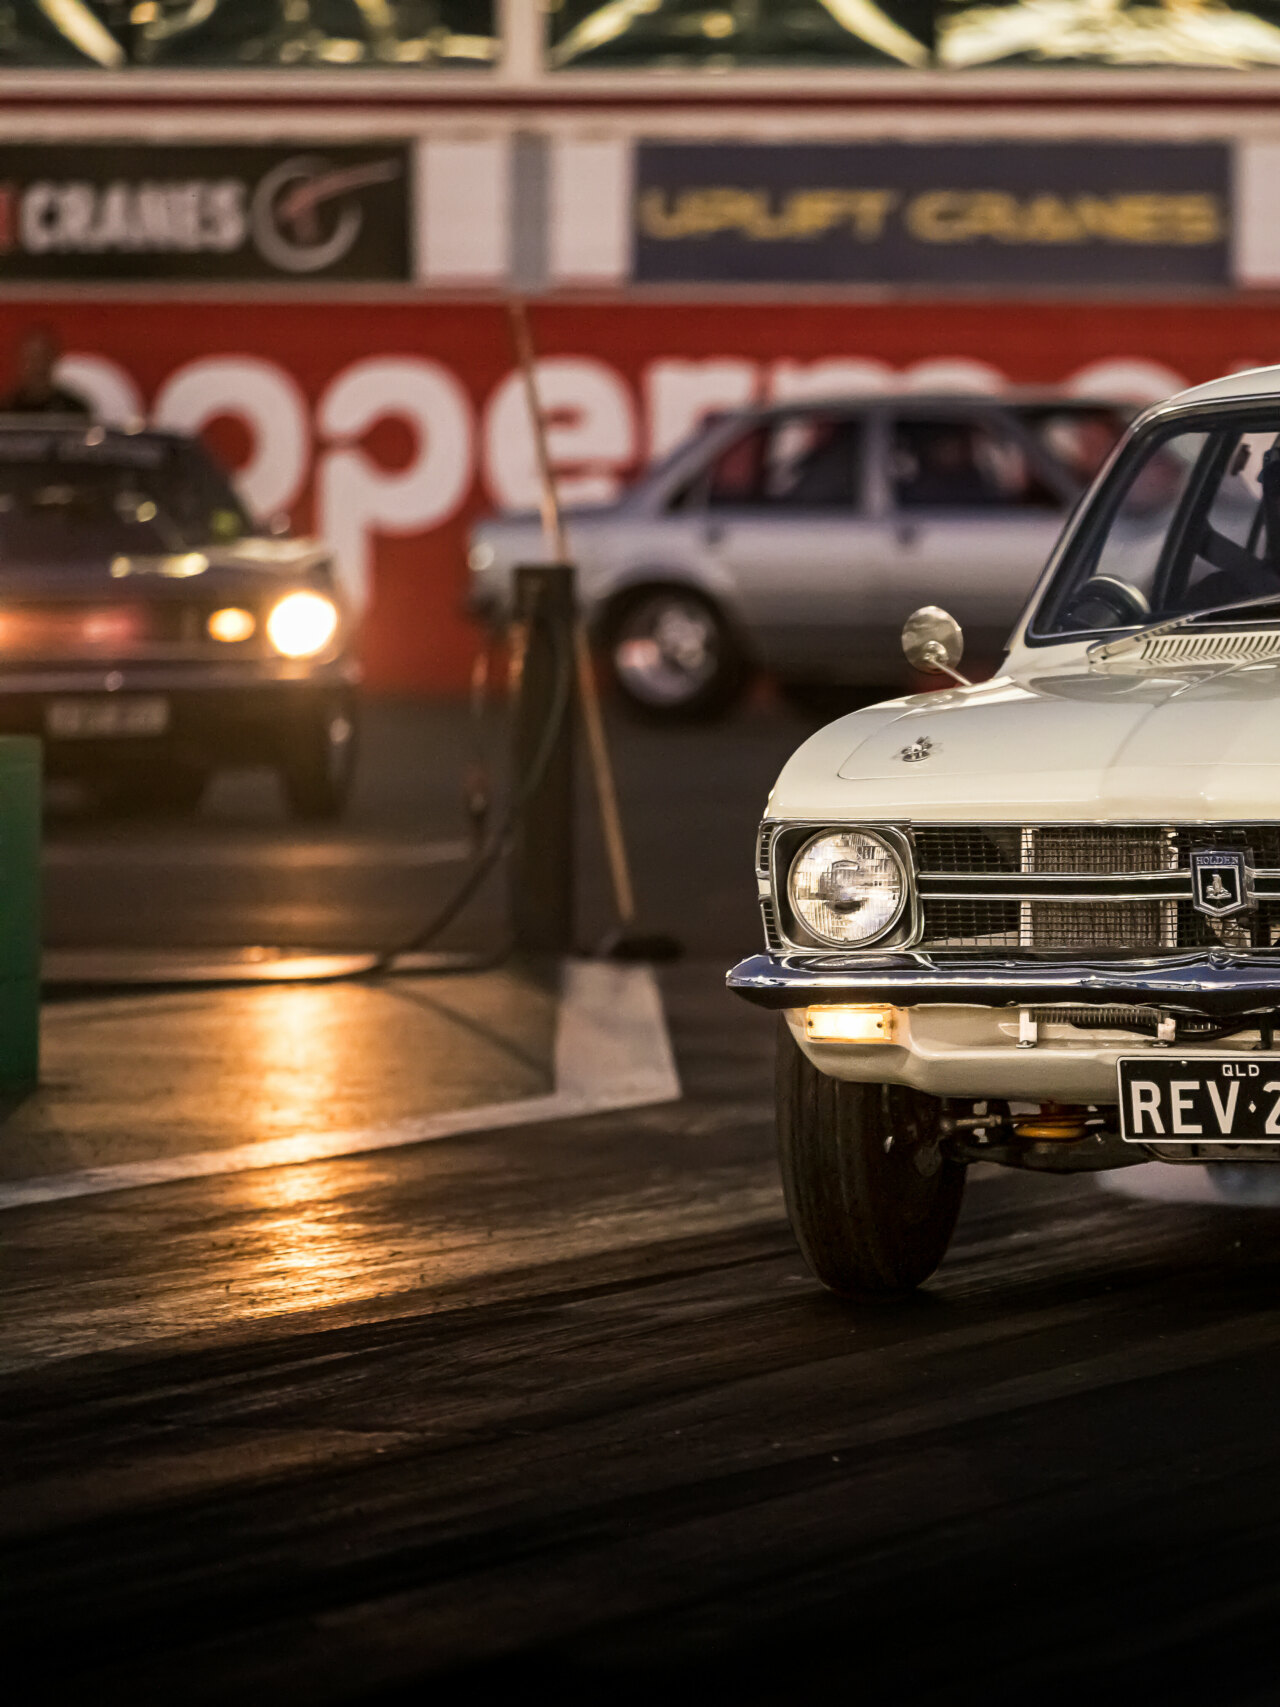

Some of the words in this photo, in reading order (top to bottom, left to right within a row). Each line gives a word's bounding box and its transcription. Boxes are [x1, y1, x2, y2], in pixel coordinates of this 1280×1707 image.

[25, 180, 244, 251] CRANES
[638, 188, 892, 241] UPLIFT
[907, 188, 1222, 244] CRANES
[1196, 856, 1239, 865] HOLDEN
[1222, 1064, 1259, 1077] QLD
[1130, 1080, 1240, 1134] REV
